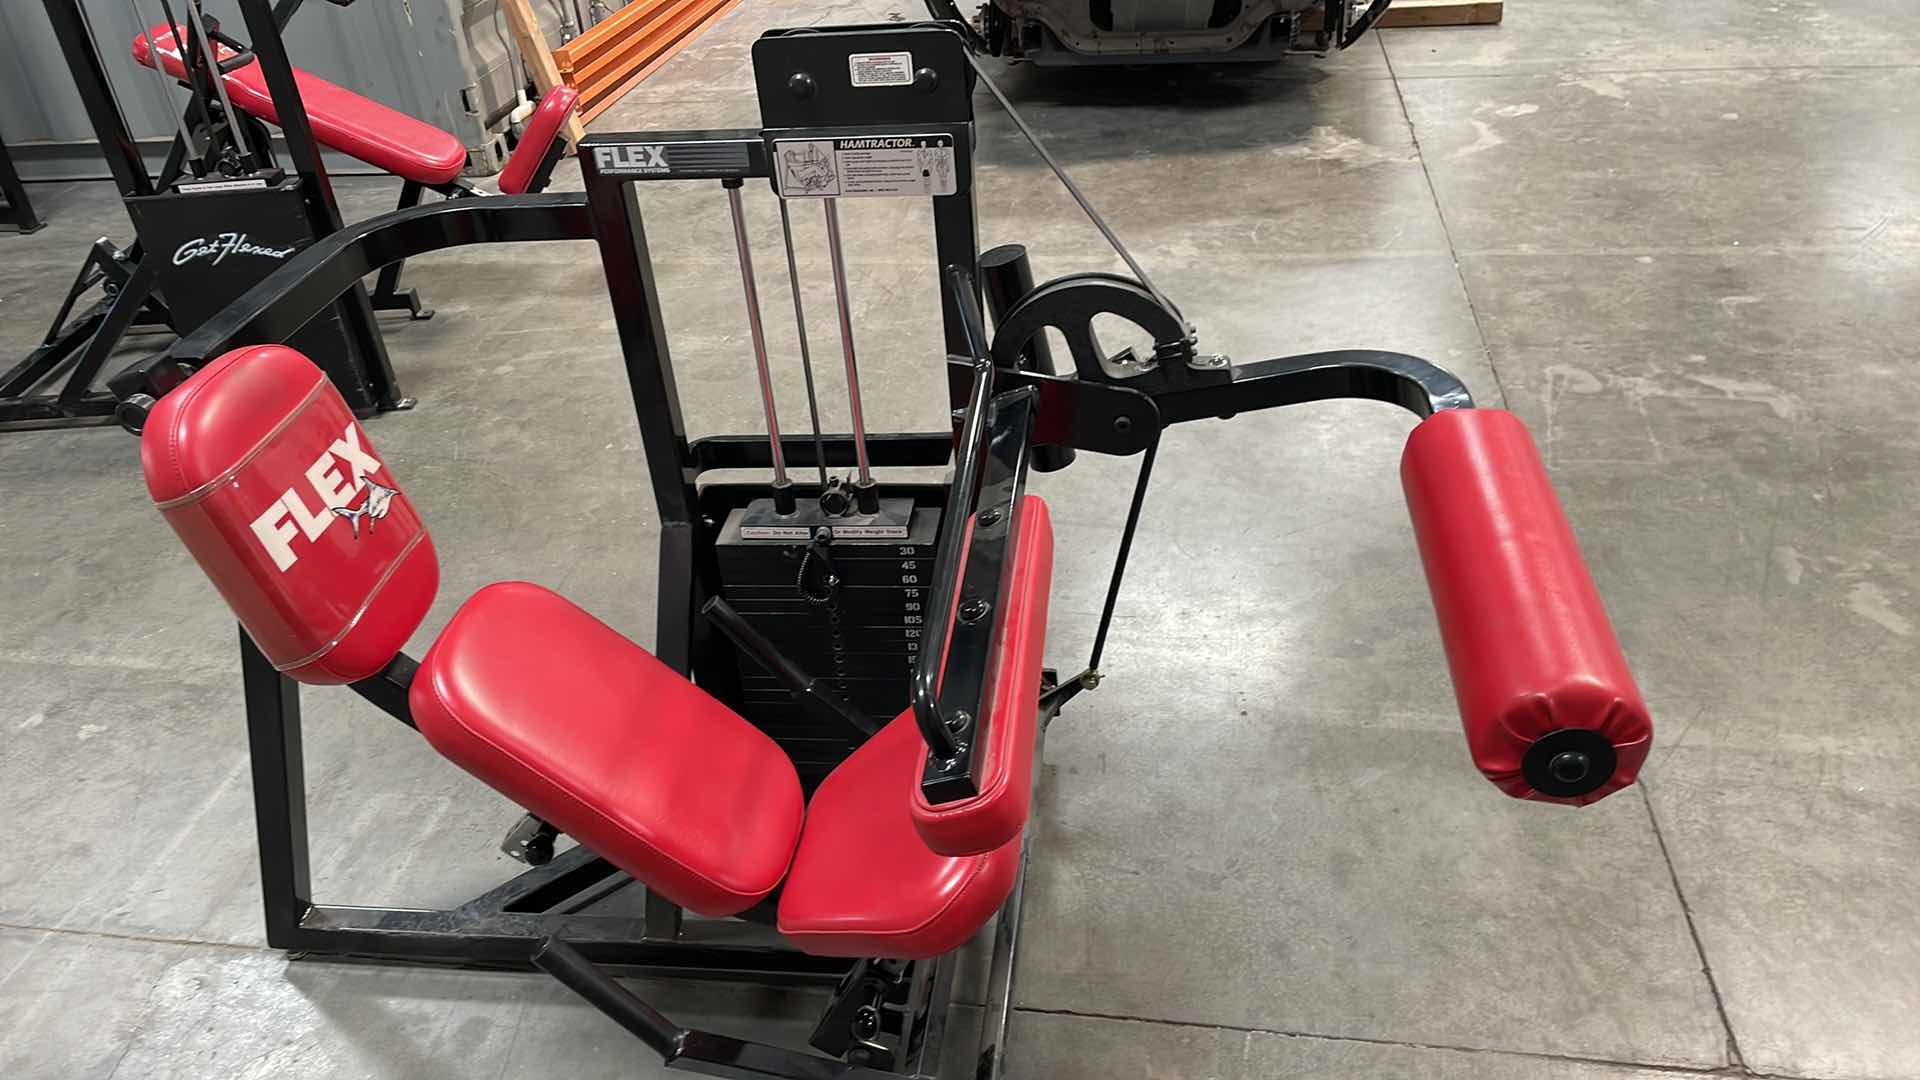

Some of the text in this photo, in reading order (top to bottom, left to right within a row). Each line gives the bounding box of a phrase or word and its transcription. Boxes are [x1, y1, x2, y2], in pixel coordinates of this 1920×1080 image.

[840, 138, 913, 149] HAMTRACTOR
[593, 145, 669, 169] FLEX
[644, 166, 671, 174] SYSTEMS
[249, 421, 382, 573] FLEX
[899, 546, 915, 555] 30
[901, 560, 917, 570] 45
[902, 575, 918, 584] 60
[904, 588, 920, 598] 75
[905, 602, 921, 611] 90
[904, 615, 923, 624] 105
